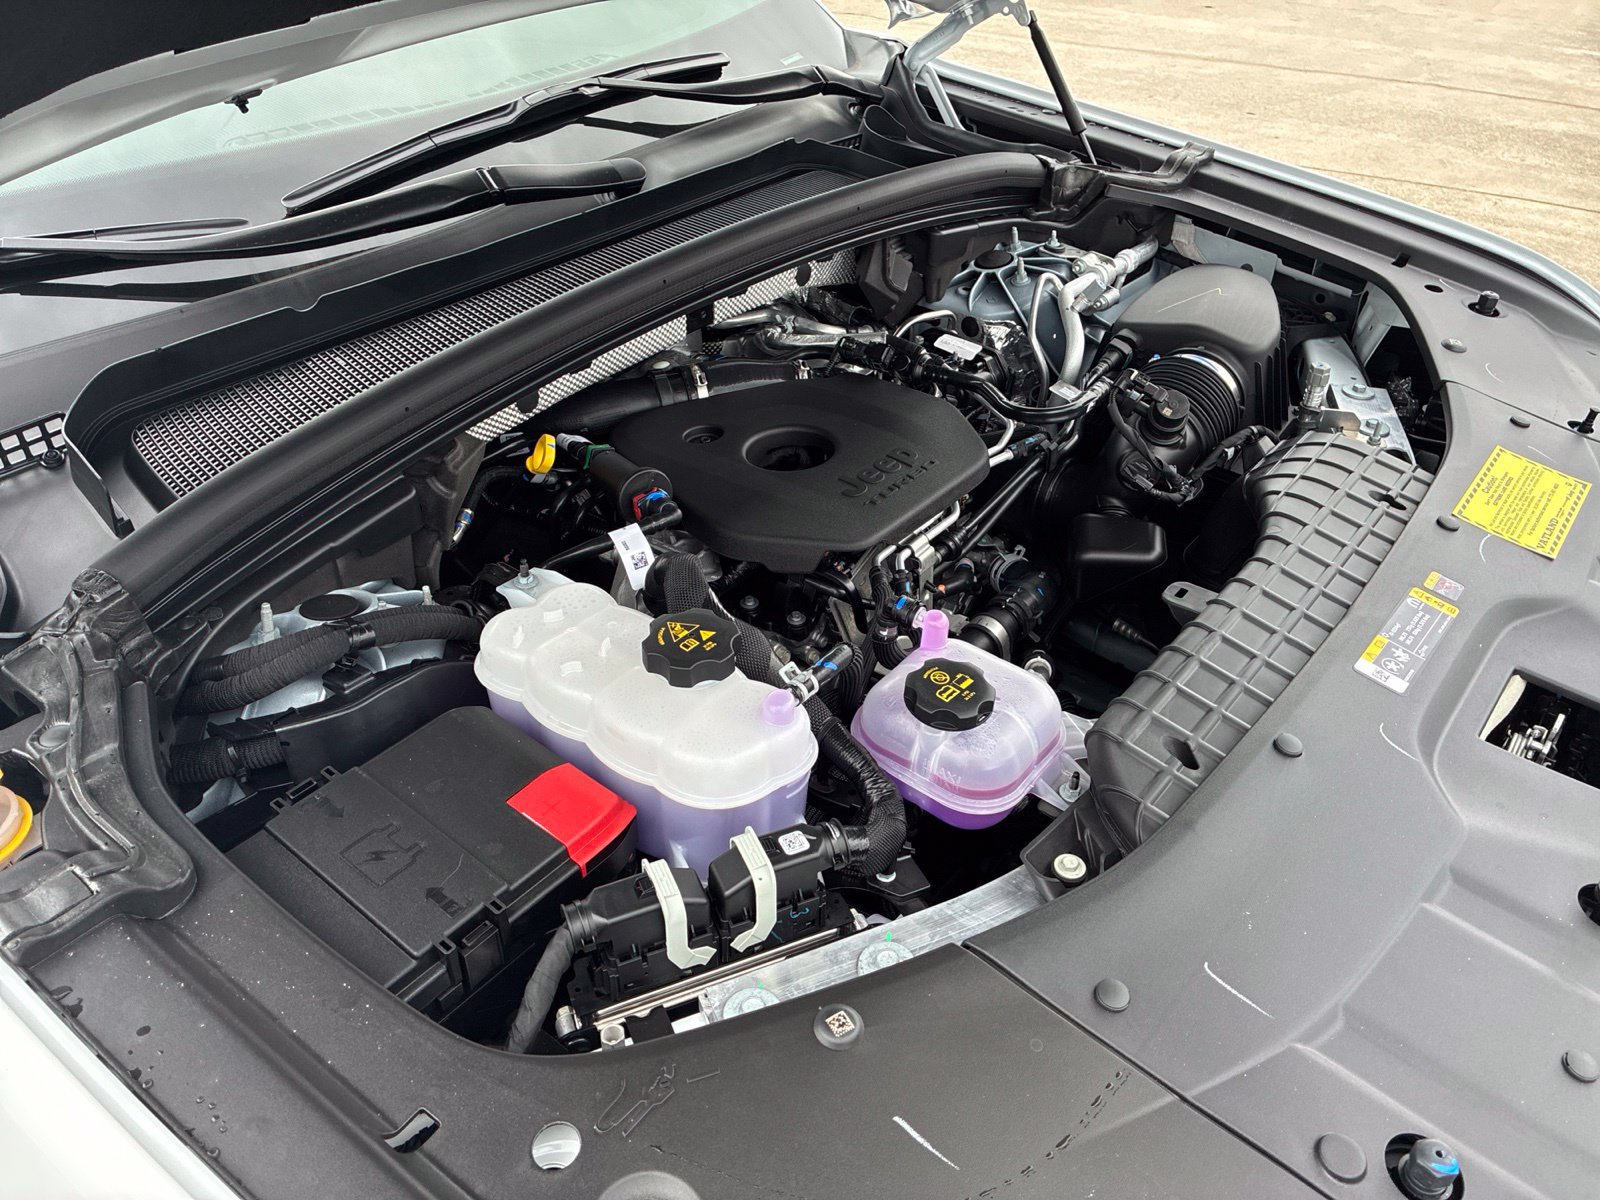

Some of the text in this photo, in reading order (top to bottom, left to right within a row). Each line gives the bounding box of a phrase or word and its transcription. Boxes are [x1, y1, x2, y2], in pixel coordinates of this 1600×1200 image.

[838, 448, 918, 497] Jeep
[862, 460, 938, 506] TURBO
[1537, 517, 1559, 550] VATLAND
